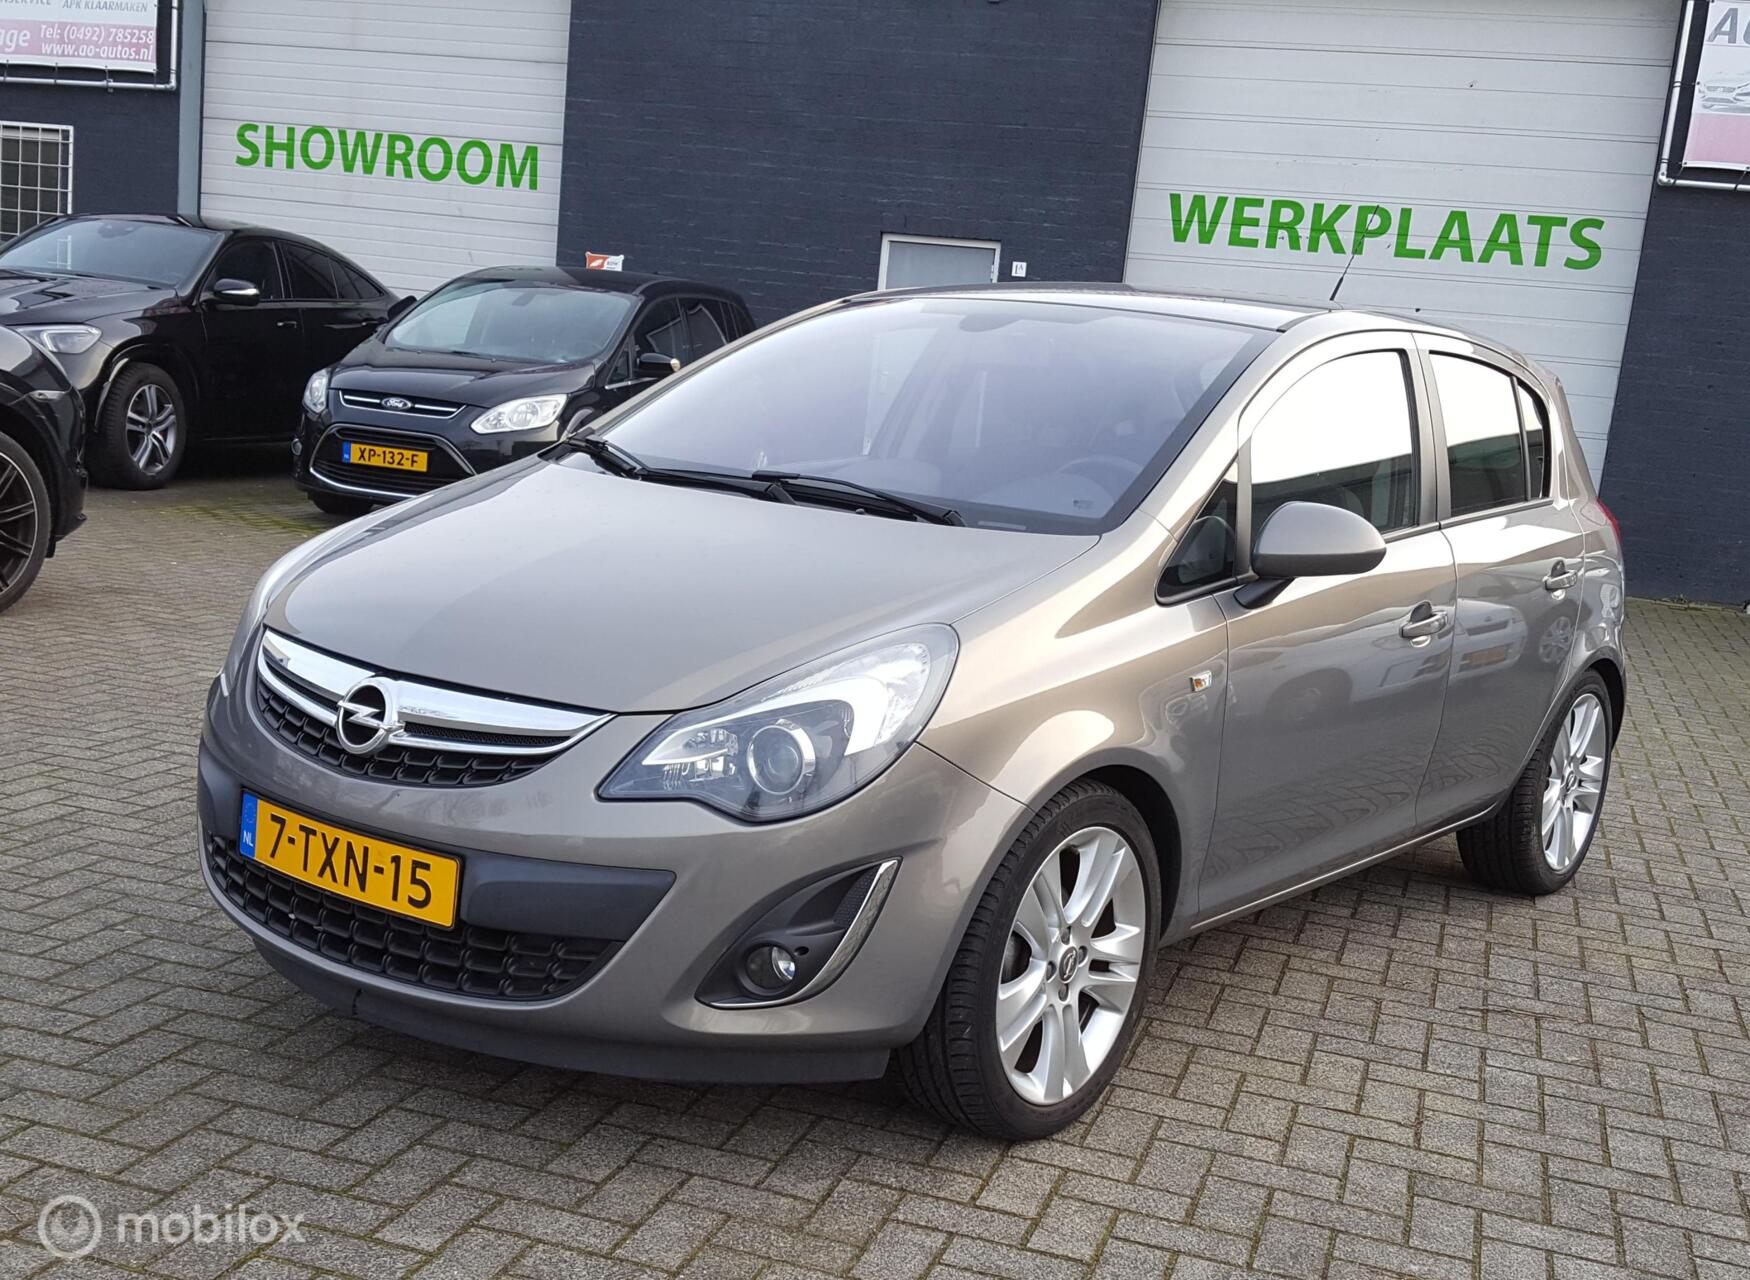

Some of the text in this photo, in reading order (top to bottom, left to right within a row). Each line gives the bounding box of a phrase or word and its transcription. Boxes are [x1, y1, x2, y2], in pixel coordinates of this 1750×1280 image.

[40, 23, 155, 45] Tel: (0492) 785258
[1707, 7, 1750, 45] A
[41, 43, 153, 60] www.ao-autos.nl
[235, 122, 539, 191] SHOWROOM
[1169, 192, 1605, 271] WERKPLAATS
[358, 447, 420, 467] XP-132-F
[242, 830, 254, 848] NL
[268, 811, 433, 910] 7-TXN-15
